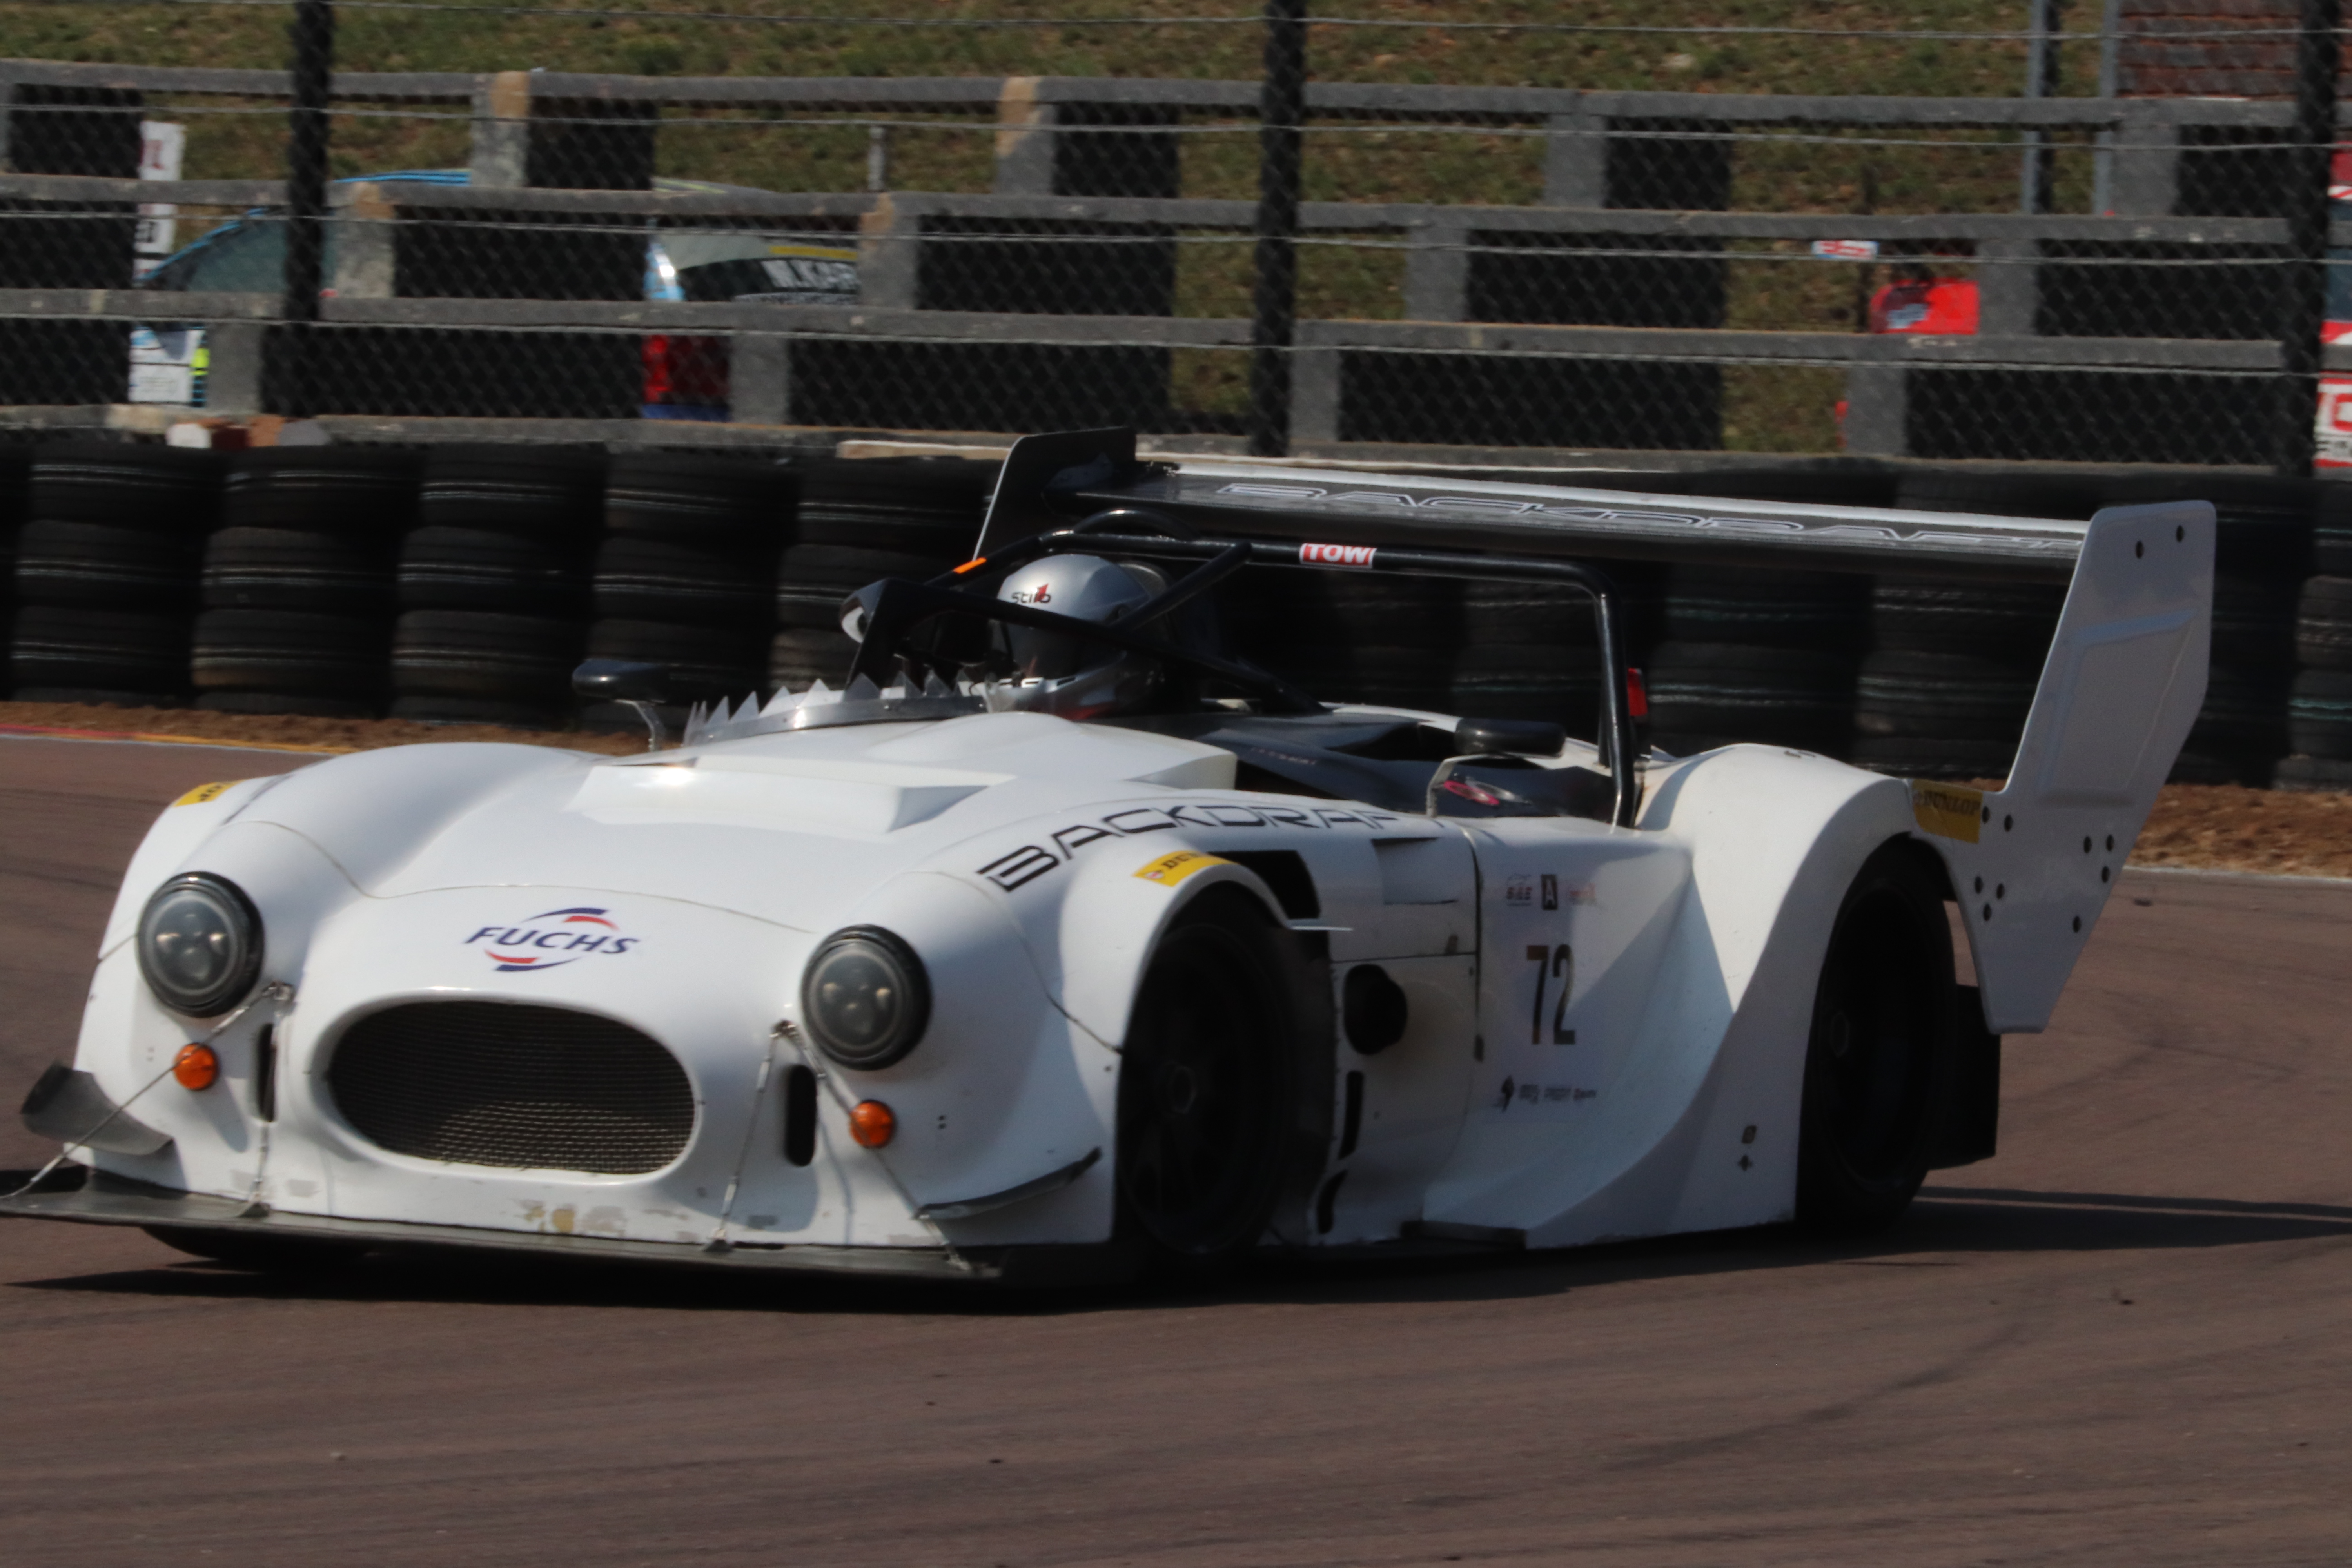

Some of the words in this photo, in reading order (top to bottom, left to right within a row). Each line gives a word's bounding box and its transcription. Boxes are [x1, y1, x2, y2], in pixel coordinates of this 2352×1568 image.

[1307, 543, 1372, 564] TOW
[462, 926, 641, 954] FUCHS
[1526, 943, 1576, 1045] 72
